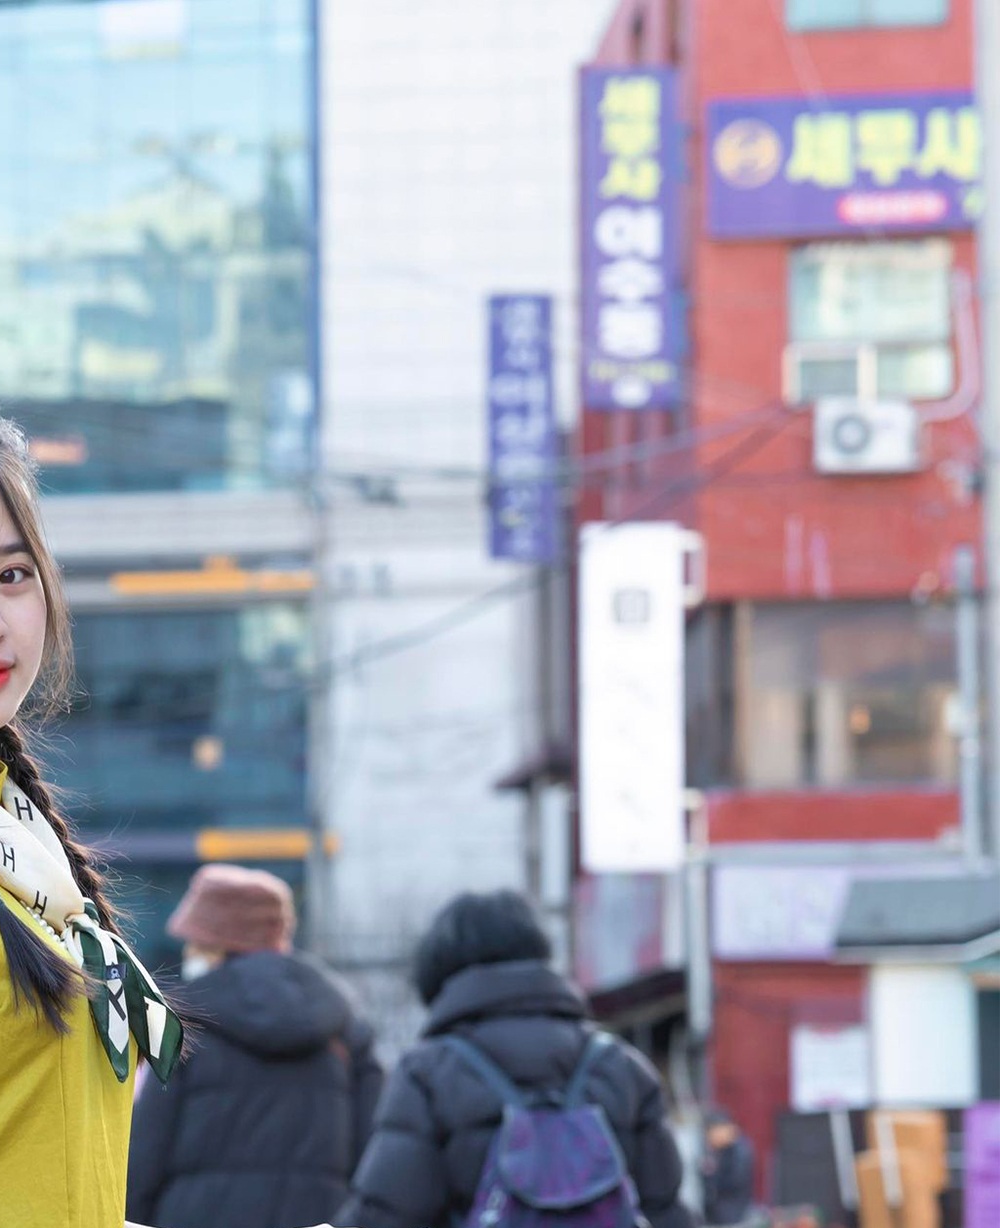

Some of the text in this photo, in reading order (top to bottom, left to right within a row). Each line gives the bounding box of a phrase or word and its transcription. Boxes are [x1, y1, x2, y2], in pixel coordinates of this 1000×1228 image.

[14, 797, 33, 821] H
[1, 843, 15, 872] H
[33, 890, 47, 916] H
